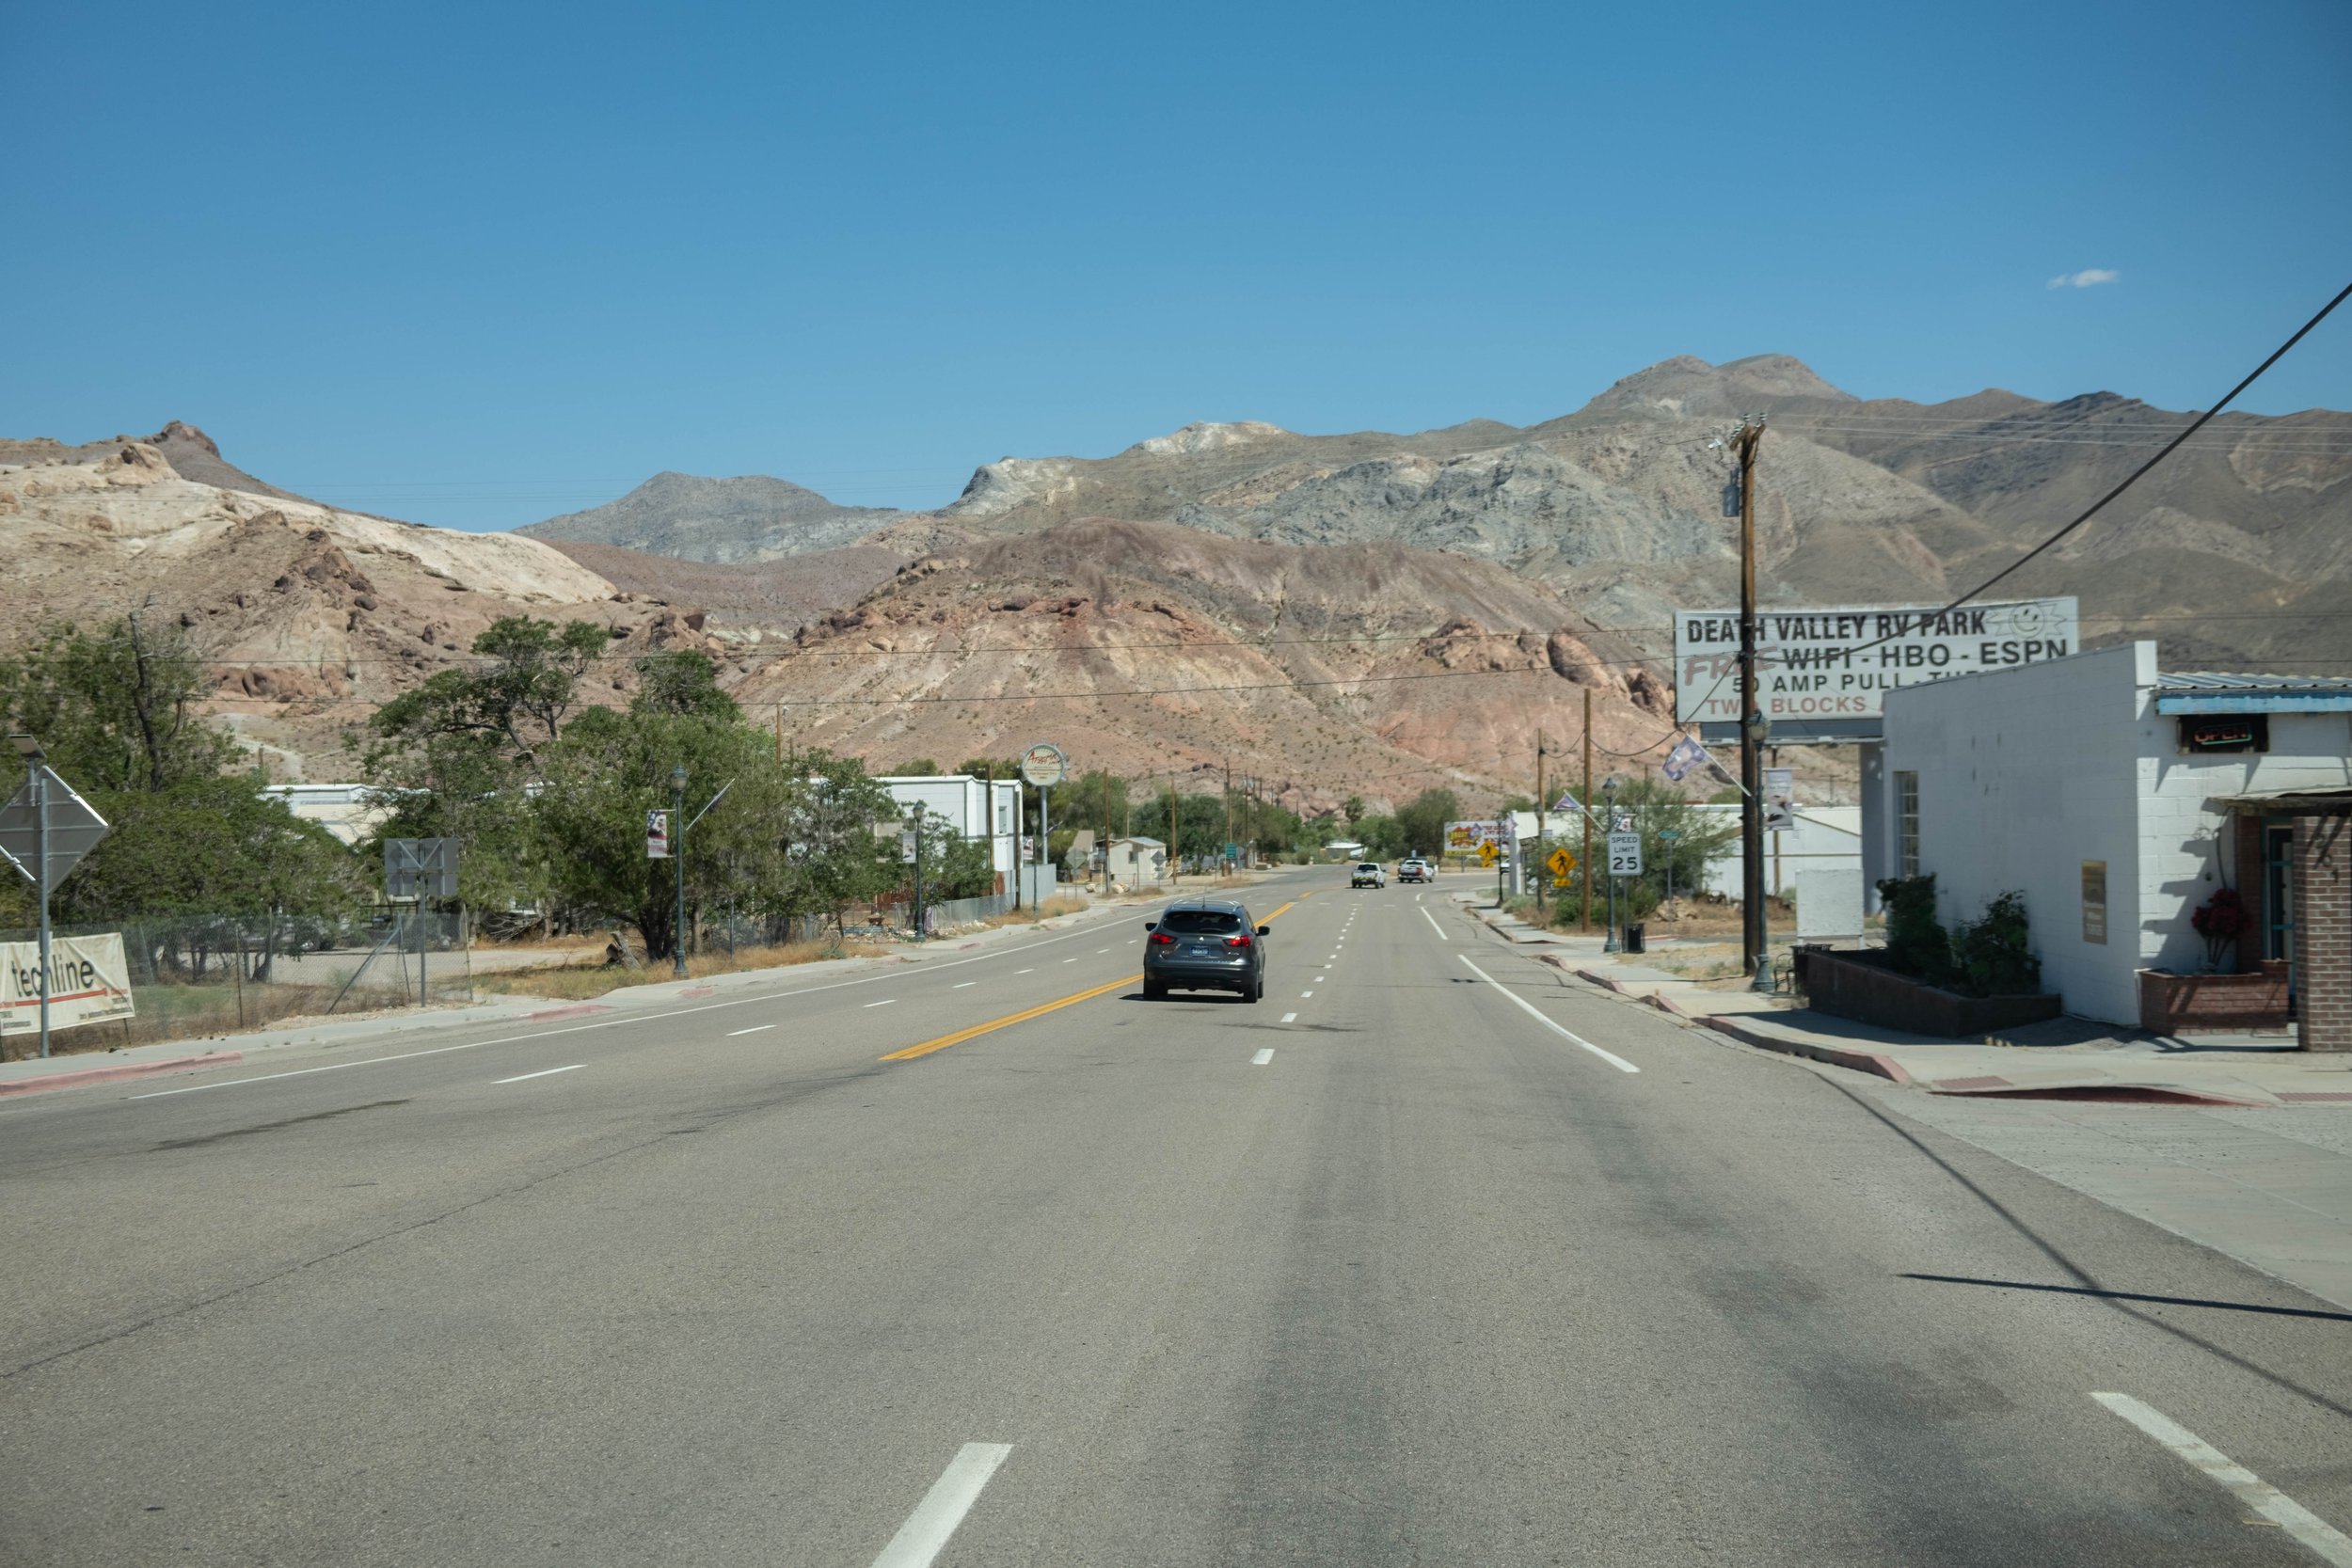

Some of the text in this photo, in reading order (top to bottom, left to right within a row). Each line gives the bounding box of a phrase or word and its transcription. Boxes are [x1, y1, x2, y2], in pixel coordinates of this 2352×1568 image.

[1776, 614, 1867, 641] VALLEY
[1876, 613, 1910, 638] RV
[1920, 610, 1987, 638] PARK
[1782, 646, 1851, 671] WIFI
[1880, 642, 1950, 668] HBO
[1979, 638, 2068, 665] ESPN
[1772, 674, 1828, 692] AMP
[1707, 698, 1758, 715] TW
[1771, 695, 1867, 715] BLOCKS
[1613, 846, 1636, 854] LIMIT
[1613, 856, 1639, 871] 25
